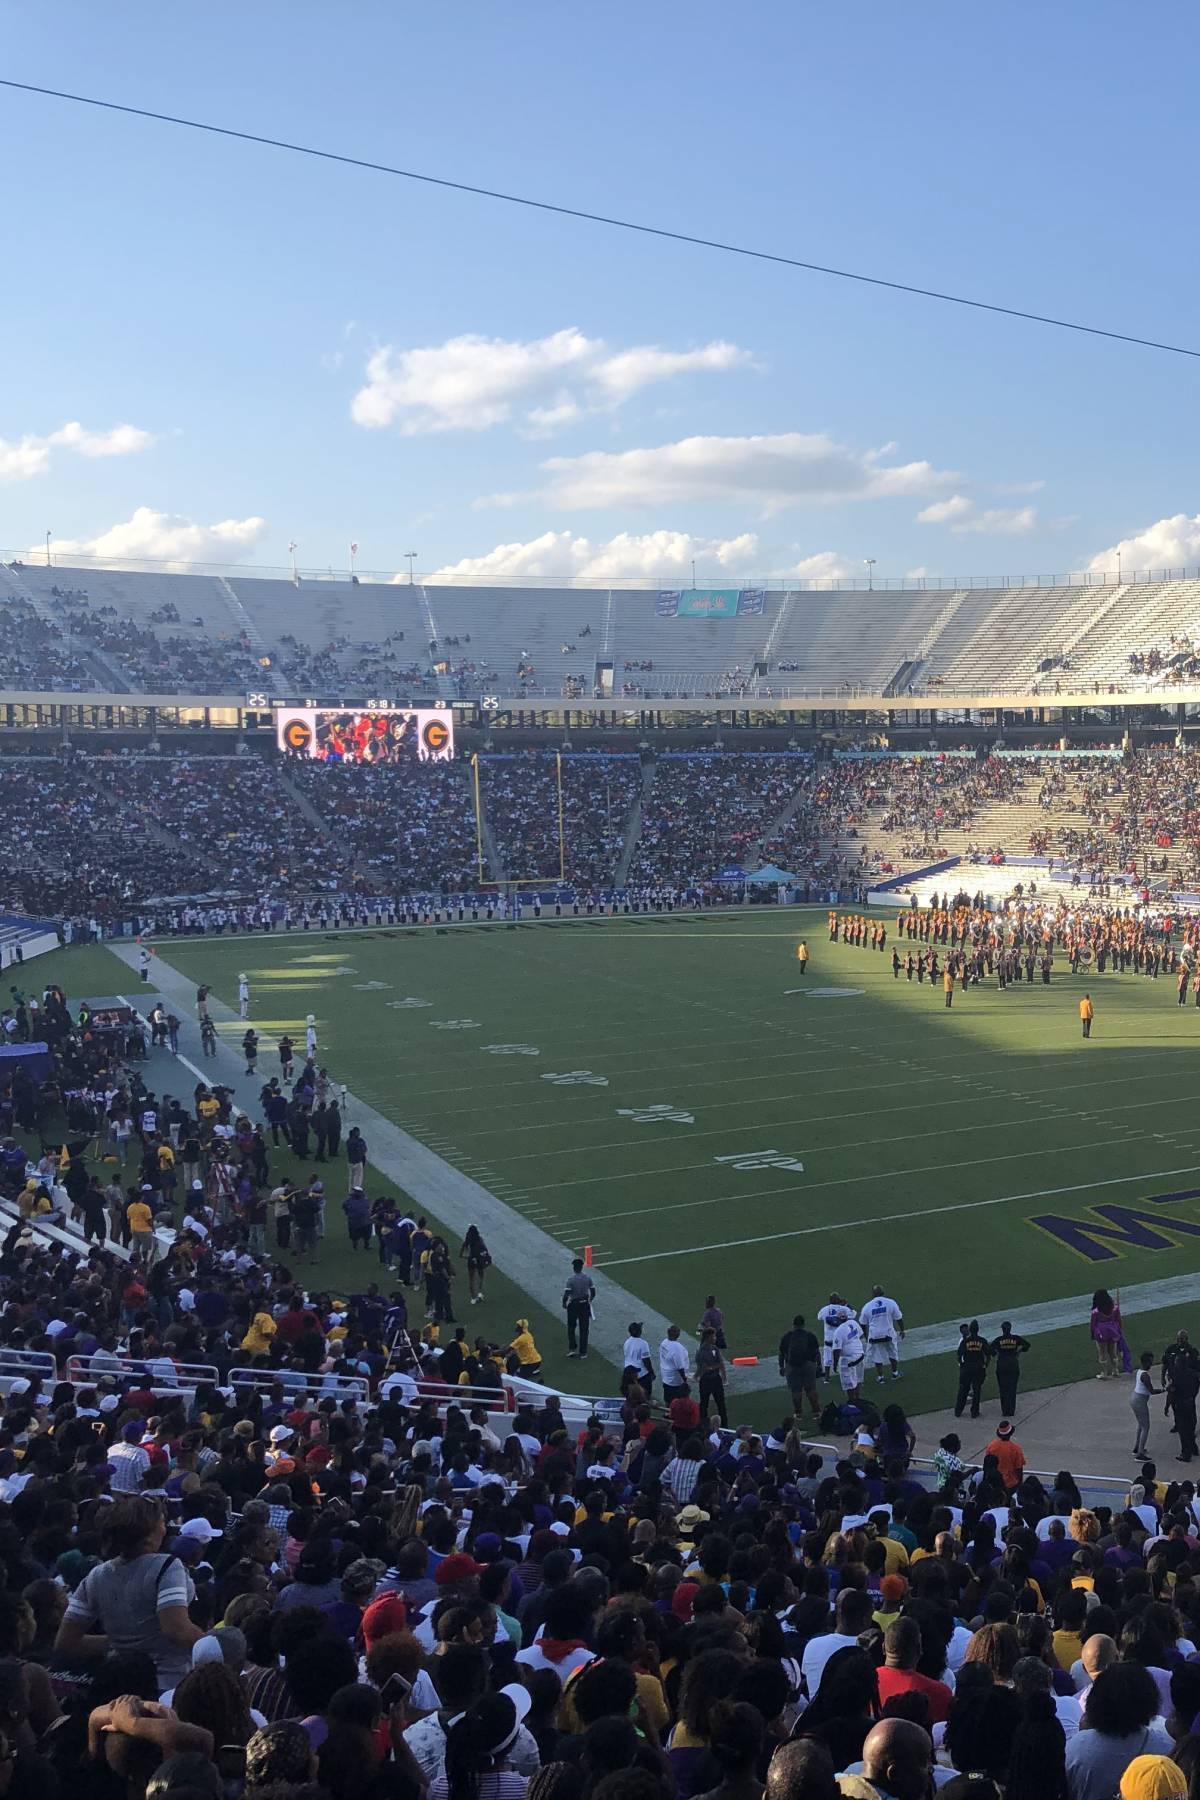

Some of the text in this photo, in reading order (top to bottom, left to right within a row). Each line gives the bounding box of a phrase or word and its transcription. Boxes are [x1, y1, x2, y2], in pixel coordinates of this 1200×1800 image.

[249, 694, 266, 706] 25
[305, 699, 316, 707] 31
[367, 699, 388, 709] 15:18
[435, 700, 446, 709] 23
[483, 697, 499, 709] 25
[283, 718, 313, 752] G
[422, 718, 450, 752] G
